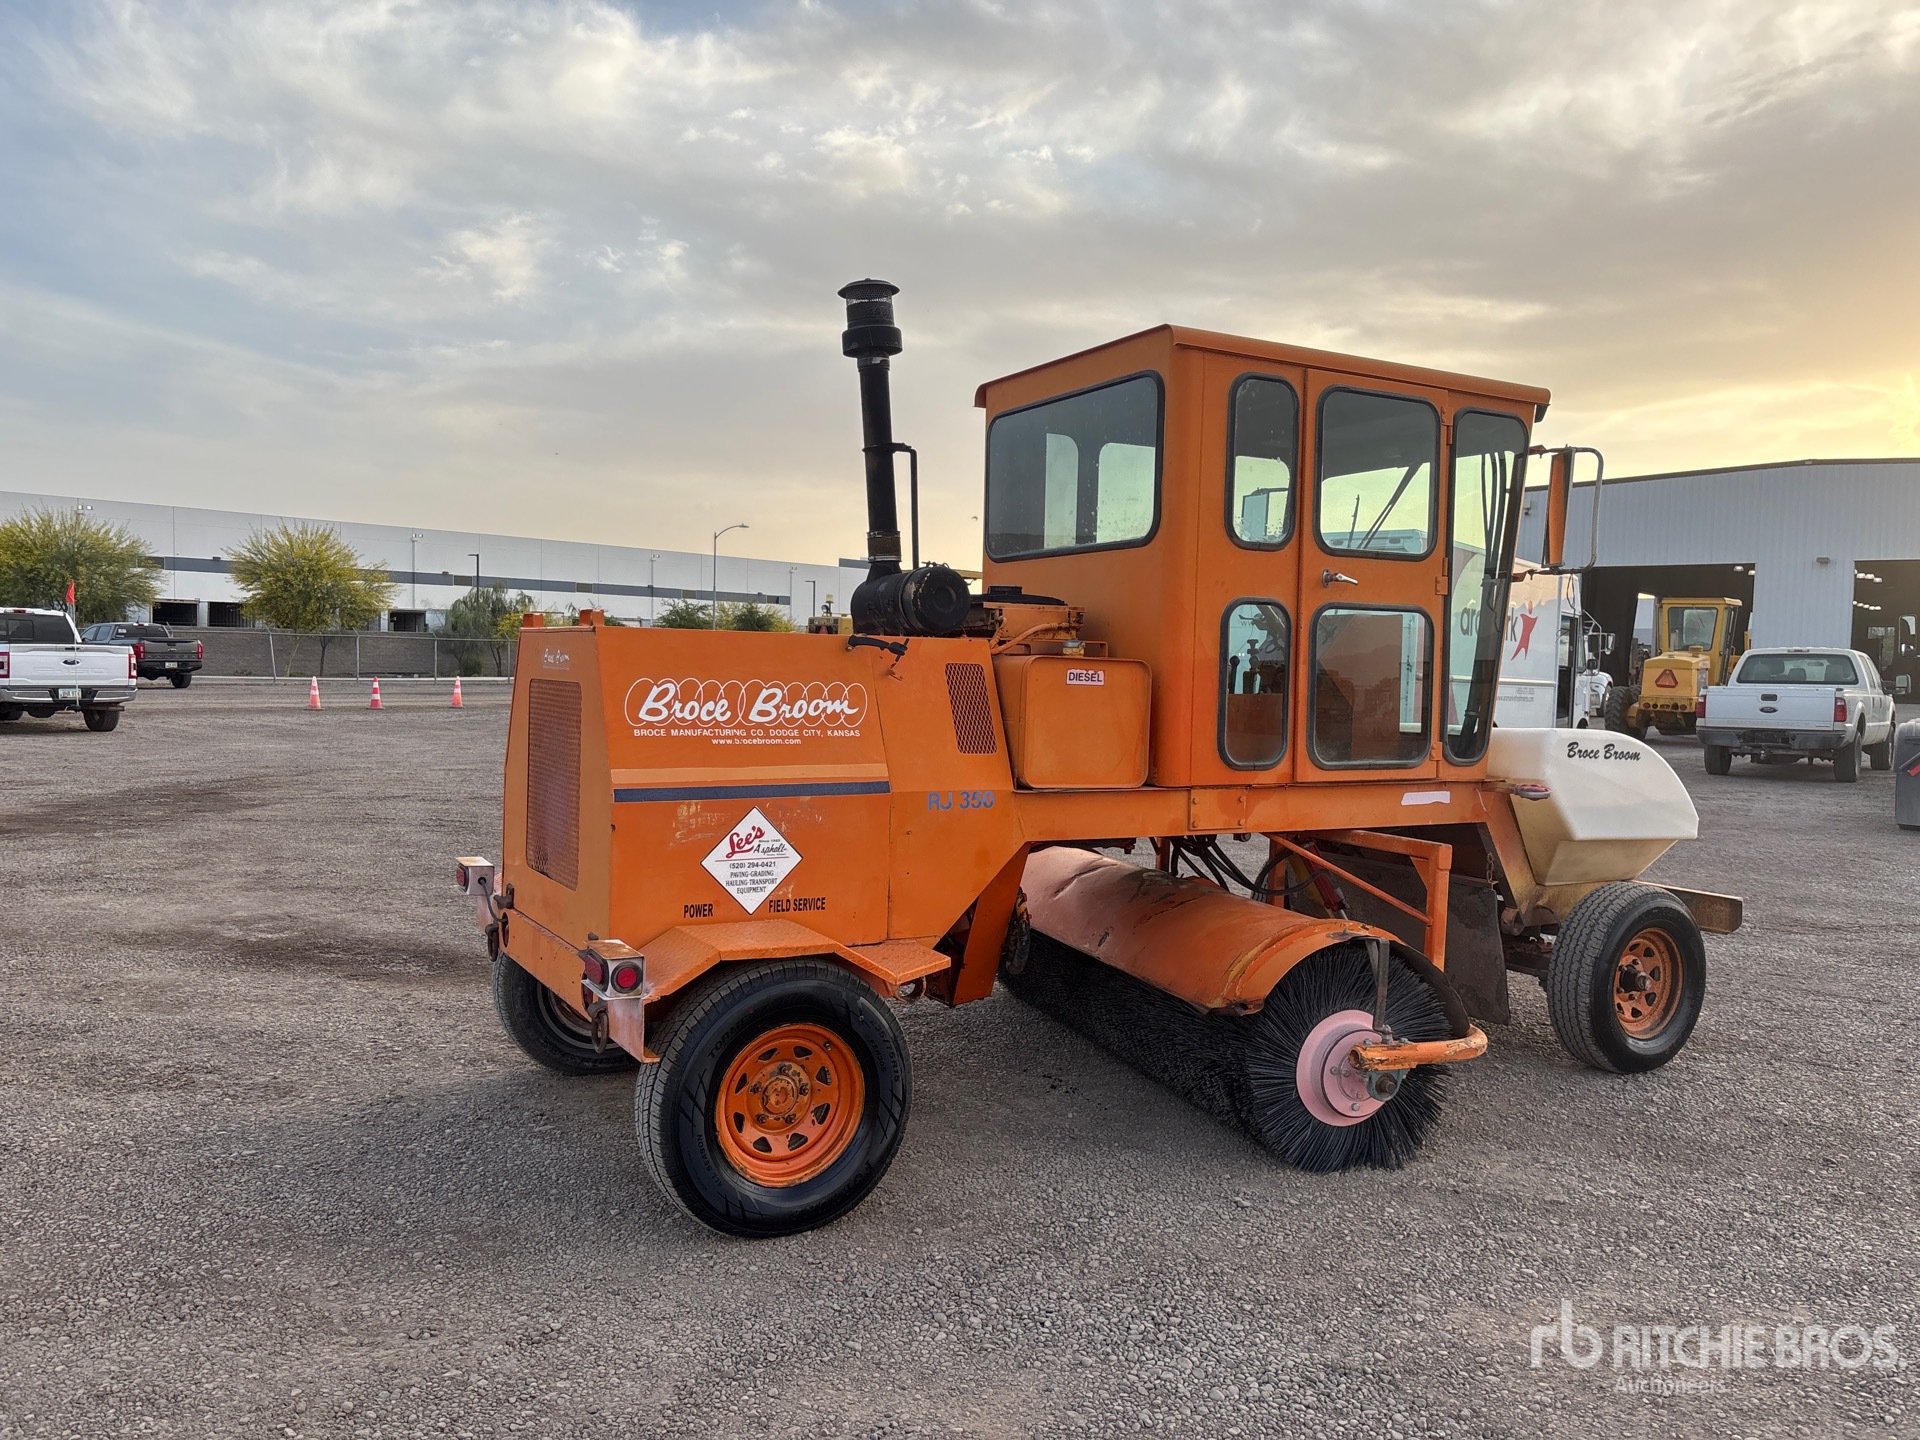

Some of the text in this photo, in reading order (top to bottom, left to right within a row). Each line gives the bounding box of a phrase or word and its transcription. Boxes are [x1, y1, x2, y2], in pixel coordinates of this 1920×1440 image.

[1460, 607, 1518, 641] arrk
[1068, 672, 1102, 682] DIESEL
[638, 682, 859, 723] Broce Broom
[633, 728, 667, 737] BROCE
[671, 728, 747, 737] MANUFACTURING
[769, 729, 800, 737] DODGE
[803, 729, 824, 738] CITY,
[827, 729, 861, 737] KANSAS
[1567, 741, 1641, 761] Broce Broom
[928, 791, 994, 810] RJ 350
[726, 825, 765, 858] Lee's
[747, 861, 776, 869] 294-0421
[737, 886, 767, 895] EQUIPMENT
[683, 904, 714, 919] POWER
[768, 897, 826, 913] FIELD SERVICE
